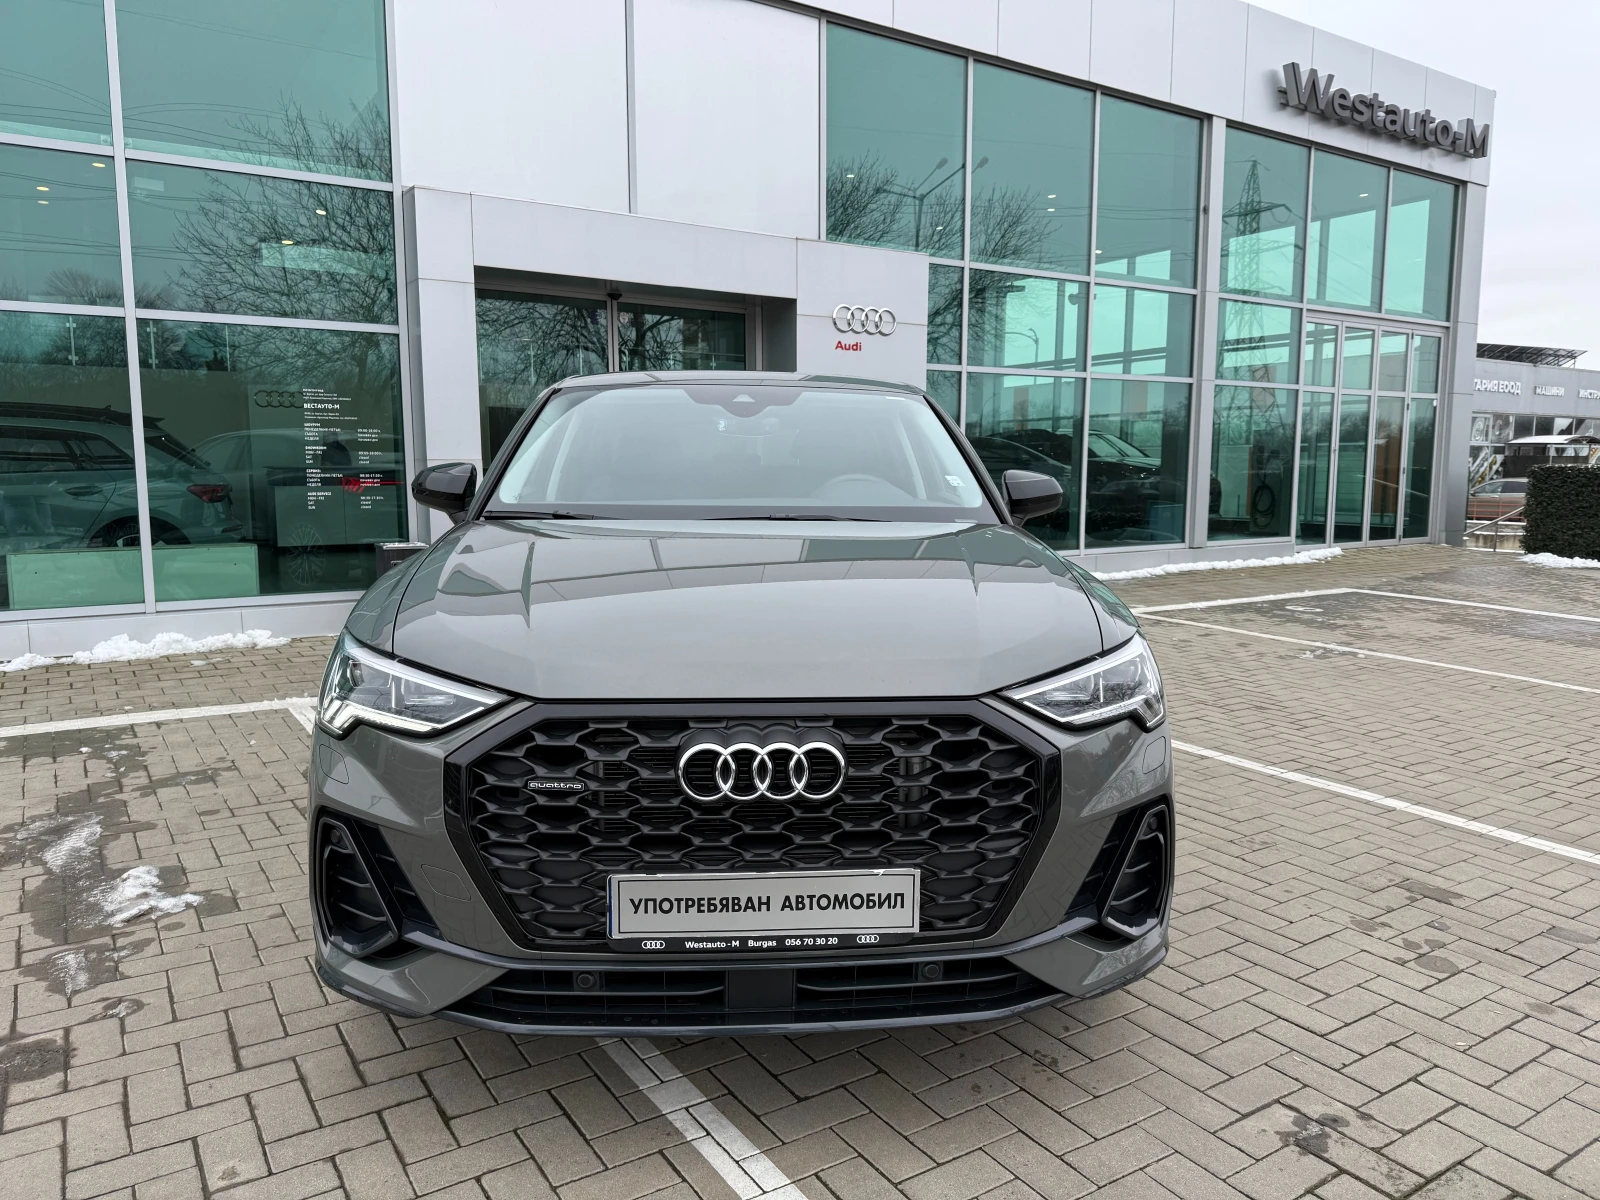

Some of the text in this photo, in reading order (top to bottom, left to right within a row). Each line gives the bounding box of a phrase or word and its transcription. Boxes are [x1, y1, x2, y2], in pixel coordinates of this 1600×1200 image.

[1282, 62, 1490, 158] Westauto-M
[835, 340, 862, 351] Audi
[1499, 381, 1521, 395] ЕООД
[1535, 386, 1564, 396] МАШИНИ
[629, 892, 904, 914] УПОТРЕБЯВАН АВТОМОБИЛ
[748, 939, 777, 948] Burgas
